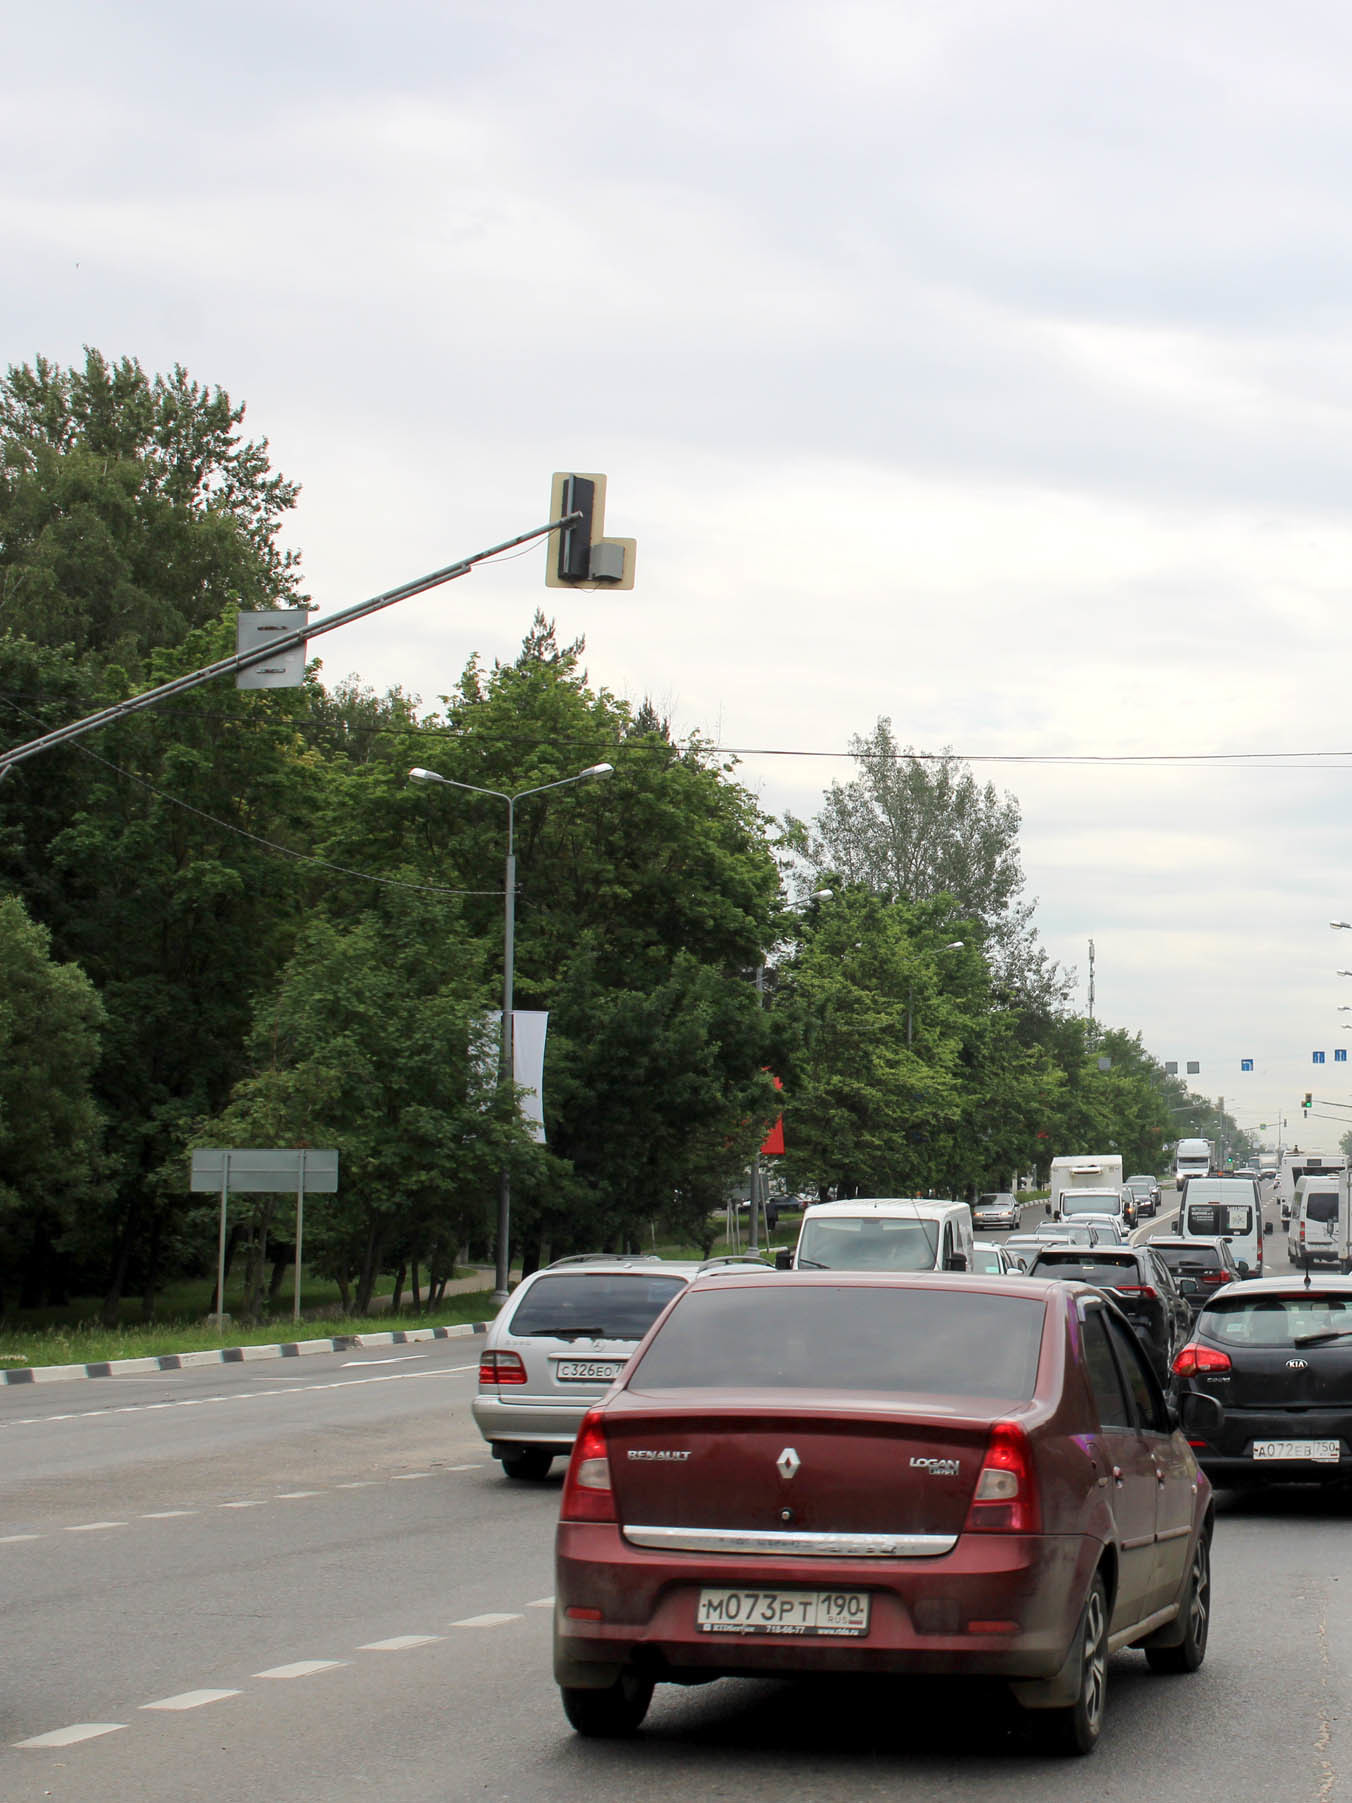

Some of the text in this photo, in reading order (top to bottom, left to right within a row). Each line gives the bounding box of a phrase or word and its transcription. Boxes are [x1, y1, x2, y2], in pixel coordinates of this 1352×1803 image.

[561, 1364, 612, 1377] С326ЕО
[627, 1450, 691, 1461] RENAULT
[909, 1457, 960, 1470] LOGAN
[706, 1594, 860, 1622] М073РТ 190
[828, 1616, 848, 1624] RUS
